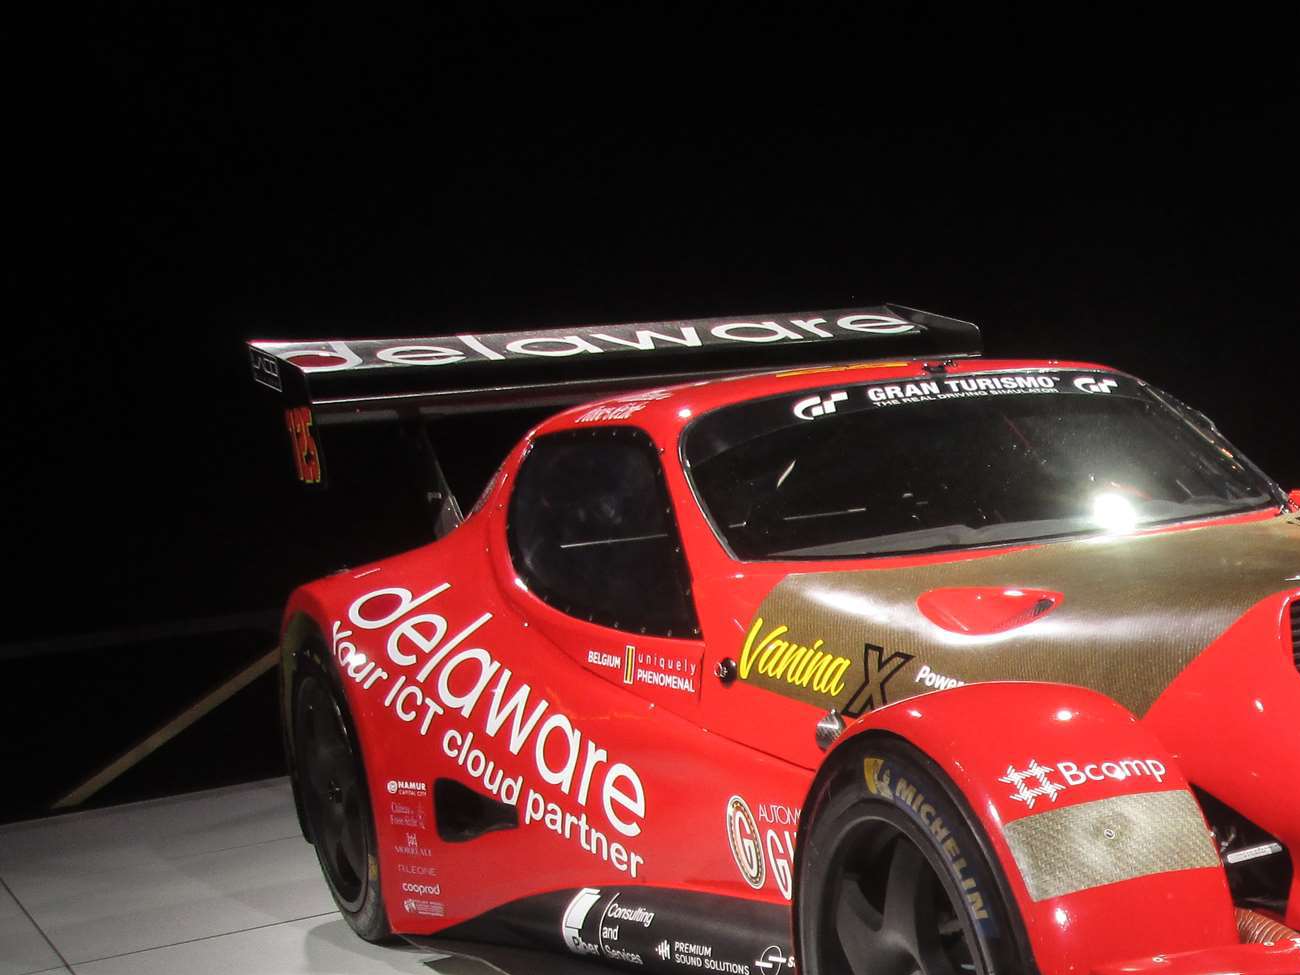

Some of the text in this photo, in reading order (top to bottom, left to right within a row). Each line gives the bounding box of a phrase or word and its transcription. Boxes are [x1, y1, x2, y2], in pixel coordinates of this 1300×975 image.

[283, 312, 916, 374] delaware
[868, 382, 941, 401] GRAN
[873, 387, 1060, 408] THE REAL DRIVING SIMULATOR
[588, 651, 621, 669] BELGIUM
[638, 654, 696, 675] uniquely
[739, 617, 916, 718] Vanina X
[637, 669, 695, 693] PHENOMENAL
[348, 582, 646, 837] delaware
[384, 675, 443, 735] ICT
[443, 729, 524, 805] cloud
[525, 789, 645, 878] partner
[1057, 759, 1166, 786] Bcomp
[398, 781, 427, 791] NAMUR
[895, 776, 990, 921] MICHELIN
[402, 882, 440, 896] cooprod
[607, 903, 655, 928] Consulting
[602, 925, 619, 940] and
[674, 941, 712, 957] PREMIUM
[674, 955, 750, 975] SOUND SOLUTIONS
